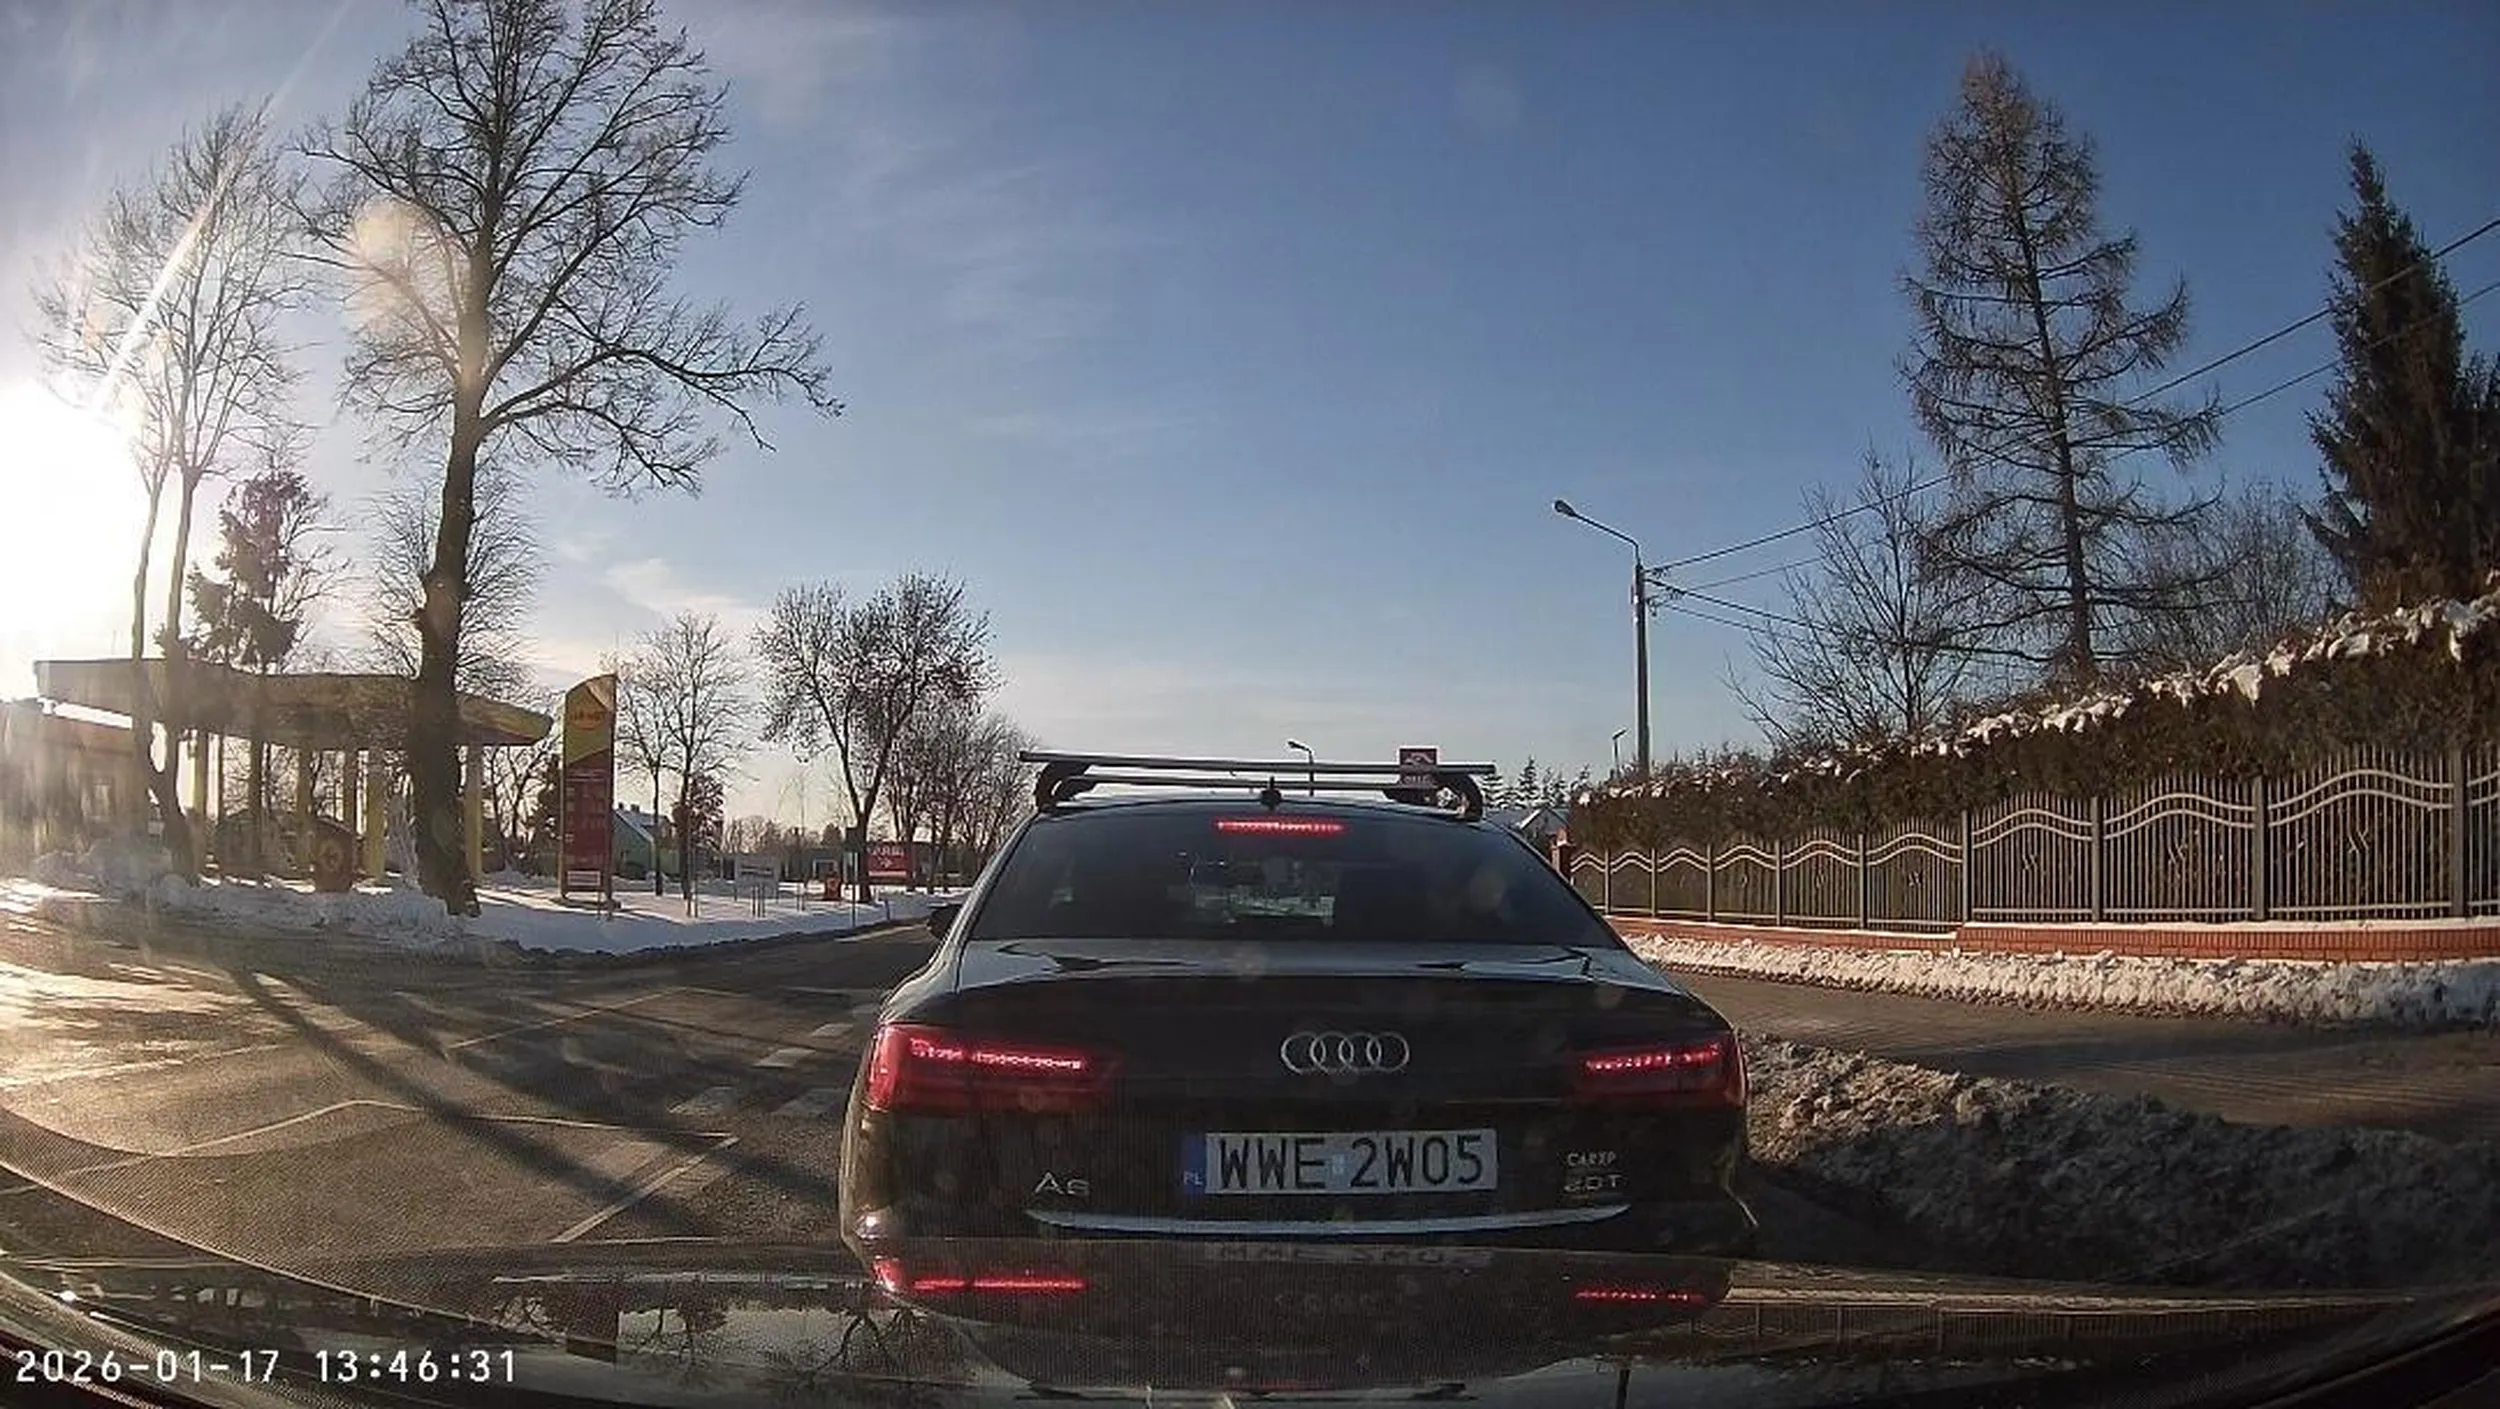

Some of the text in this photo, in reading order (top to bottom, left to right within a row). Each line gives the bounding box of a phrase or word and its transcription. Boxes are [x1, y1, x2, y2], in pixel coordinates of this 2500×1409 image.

[1183, 1170, 1204, 1186] PL
[1219, 1134, 1483, 1190] WWE 2W05
